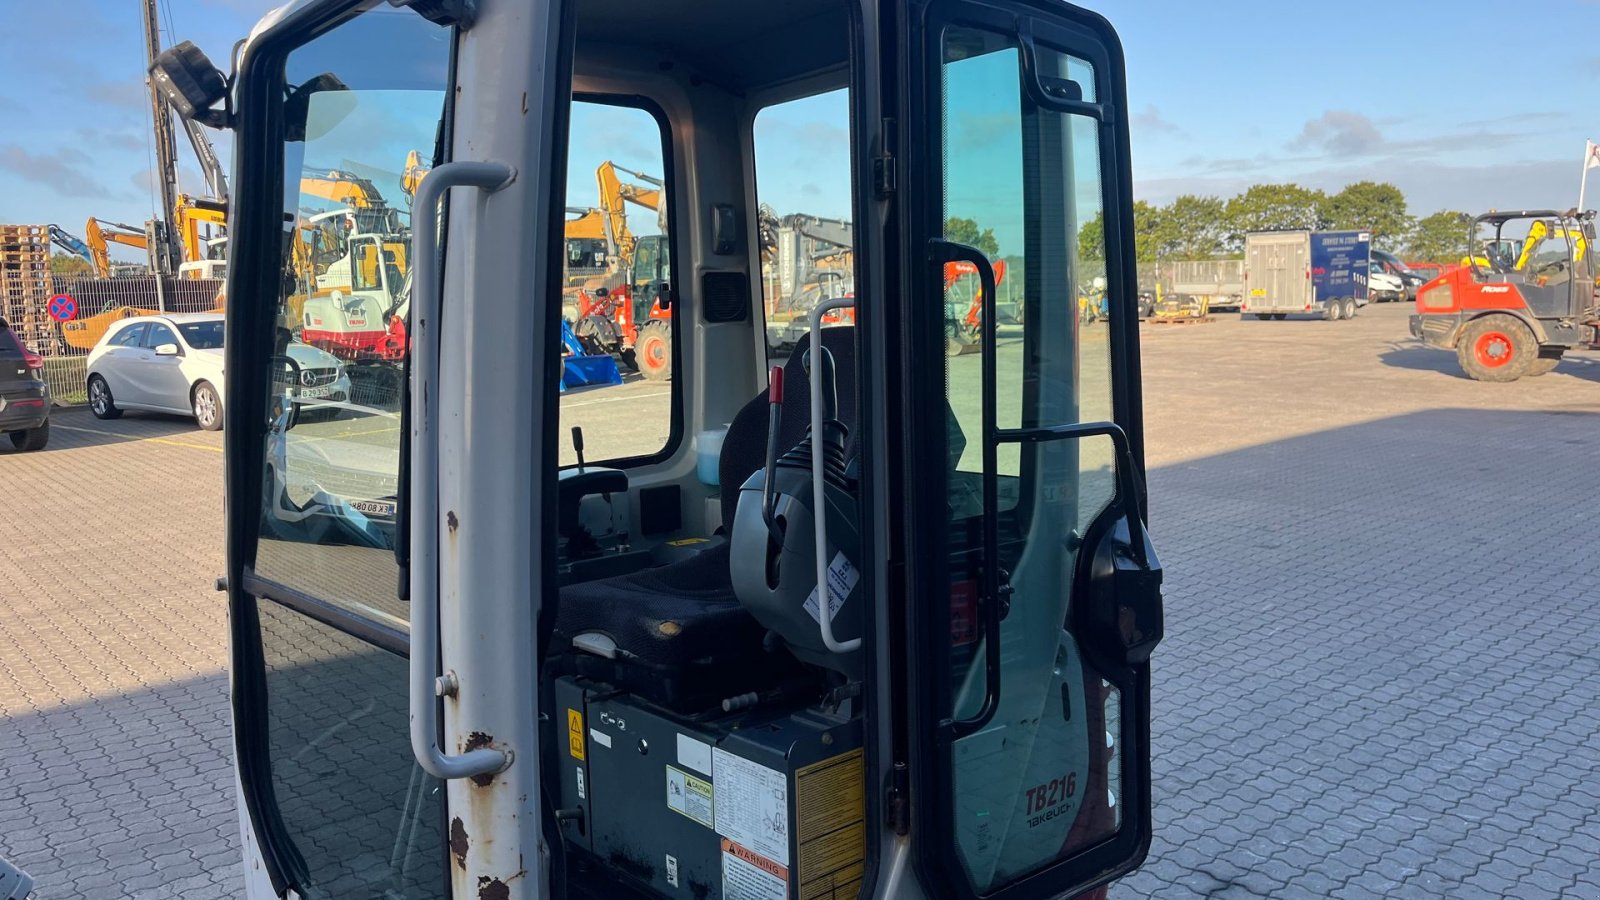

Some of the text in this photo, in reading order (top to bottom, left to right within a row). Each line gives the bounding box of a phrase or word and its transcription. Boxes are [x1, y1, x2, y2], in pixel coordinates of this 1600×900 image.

[692, 781, 711, 795] CAUTION
[1026, 771, 1077, 816] TB216
[736, 847, 779, 874] WARNING
